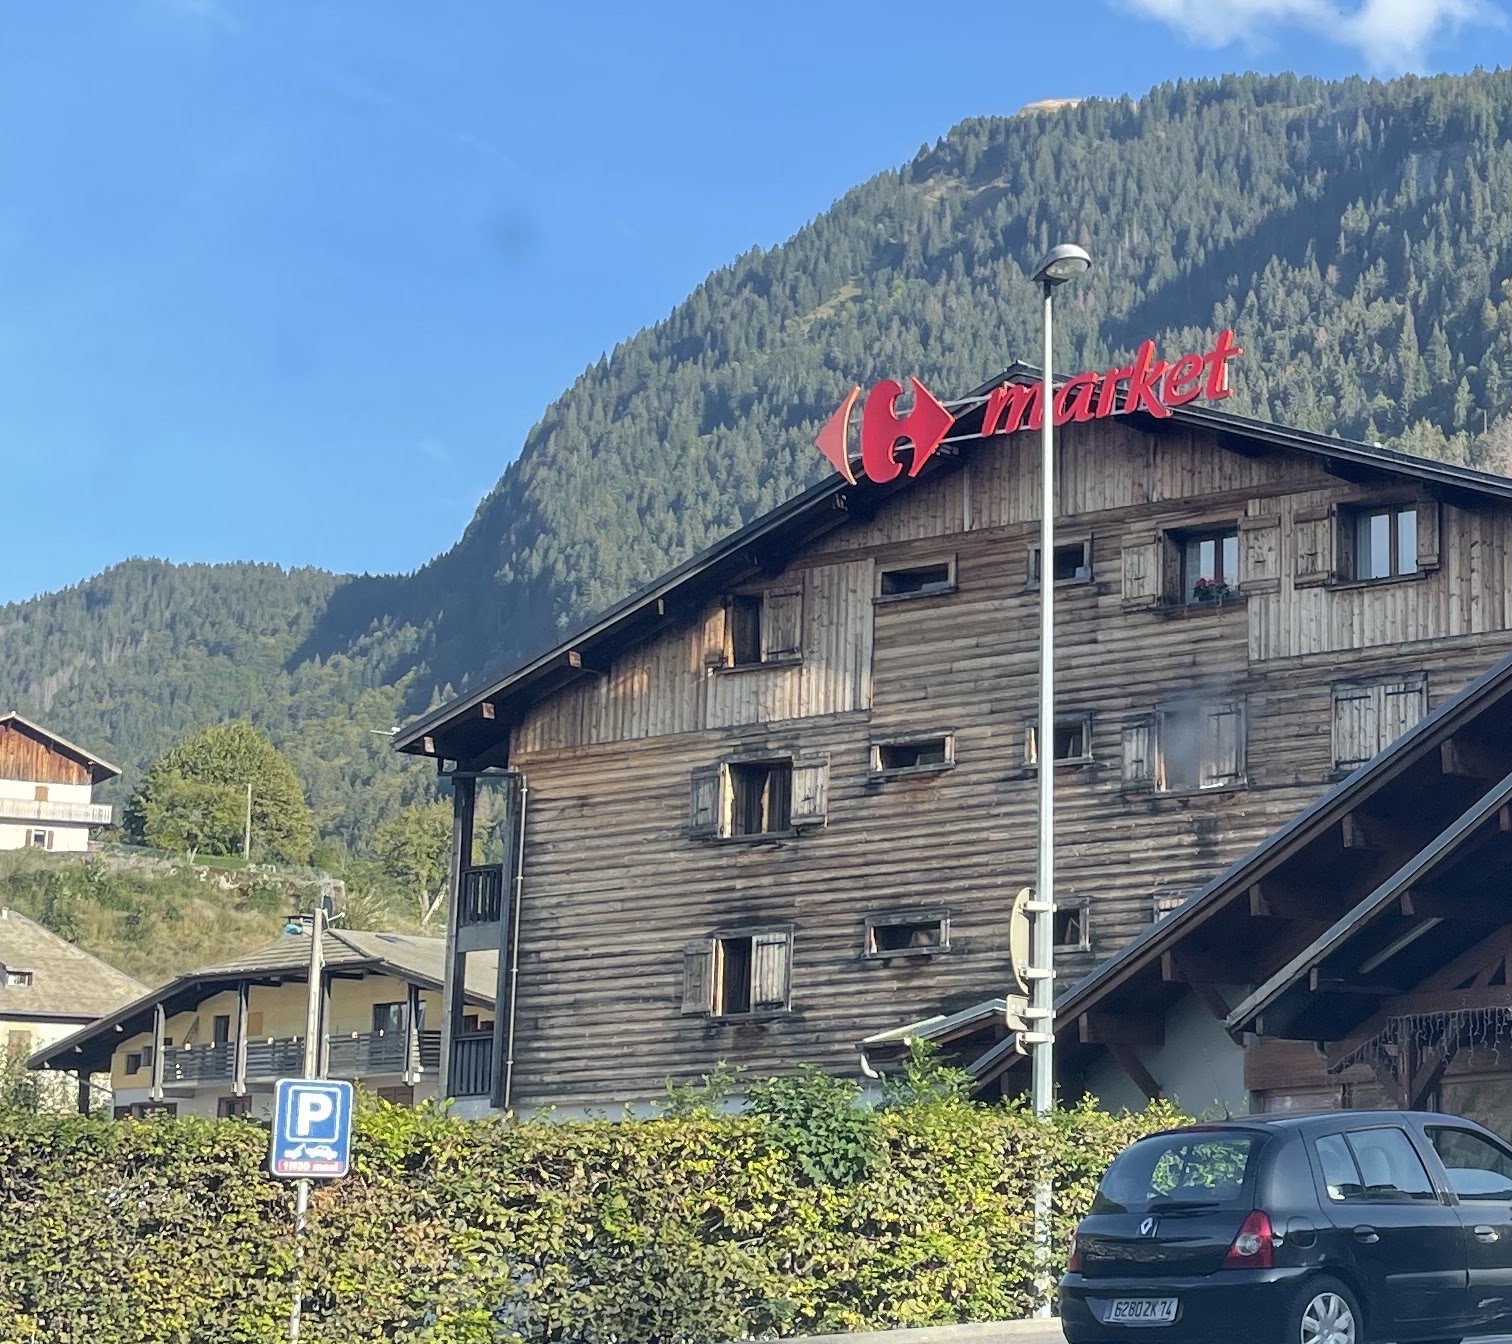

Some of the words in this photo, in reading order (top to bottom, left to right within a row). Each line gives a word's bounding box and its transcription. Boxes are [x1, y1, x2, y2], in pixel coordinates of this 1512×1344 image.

[981, 329, 1244, 437] market
[297, 1092, 333, 1137] P
[1143, 1300, 1159, 1317] ZK
